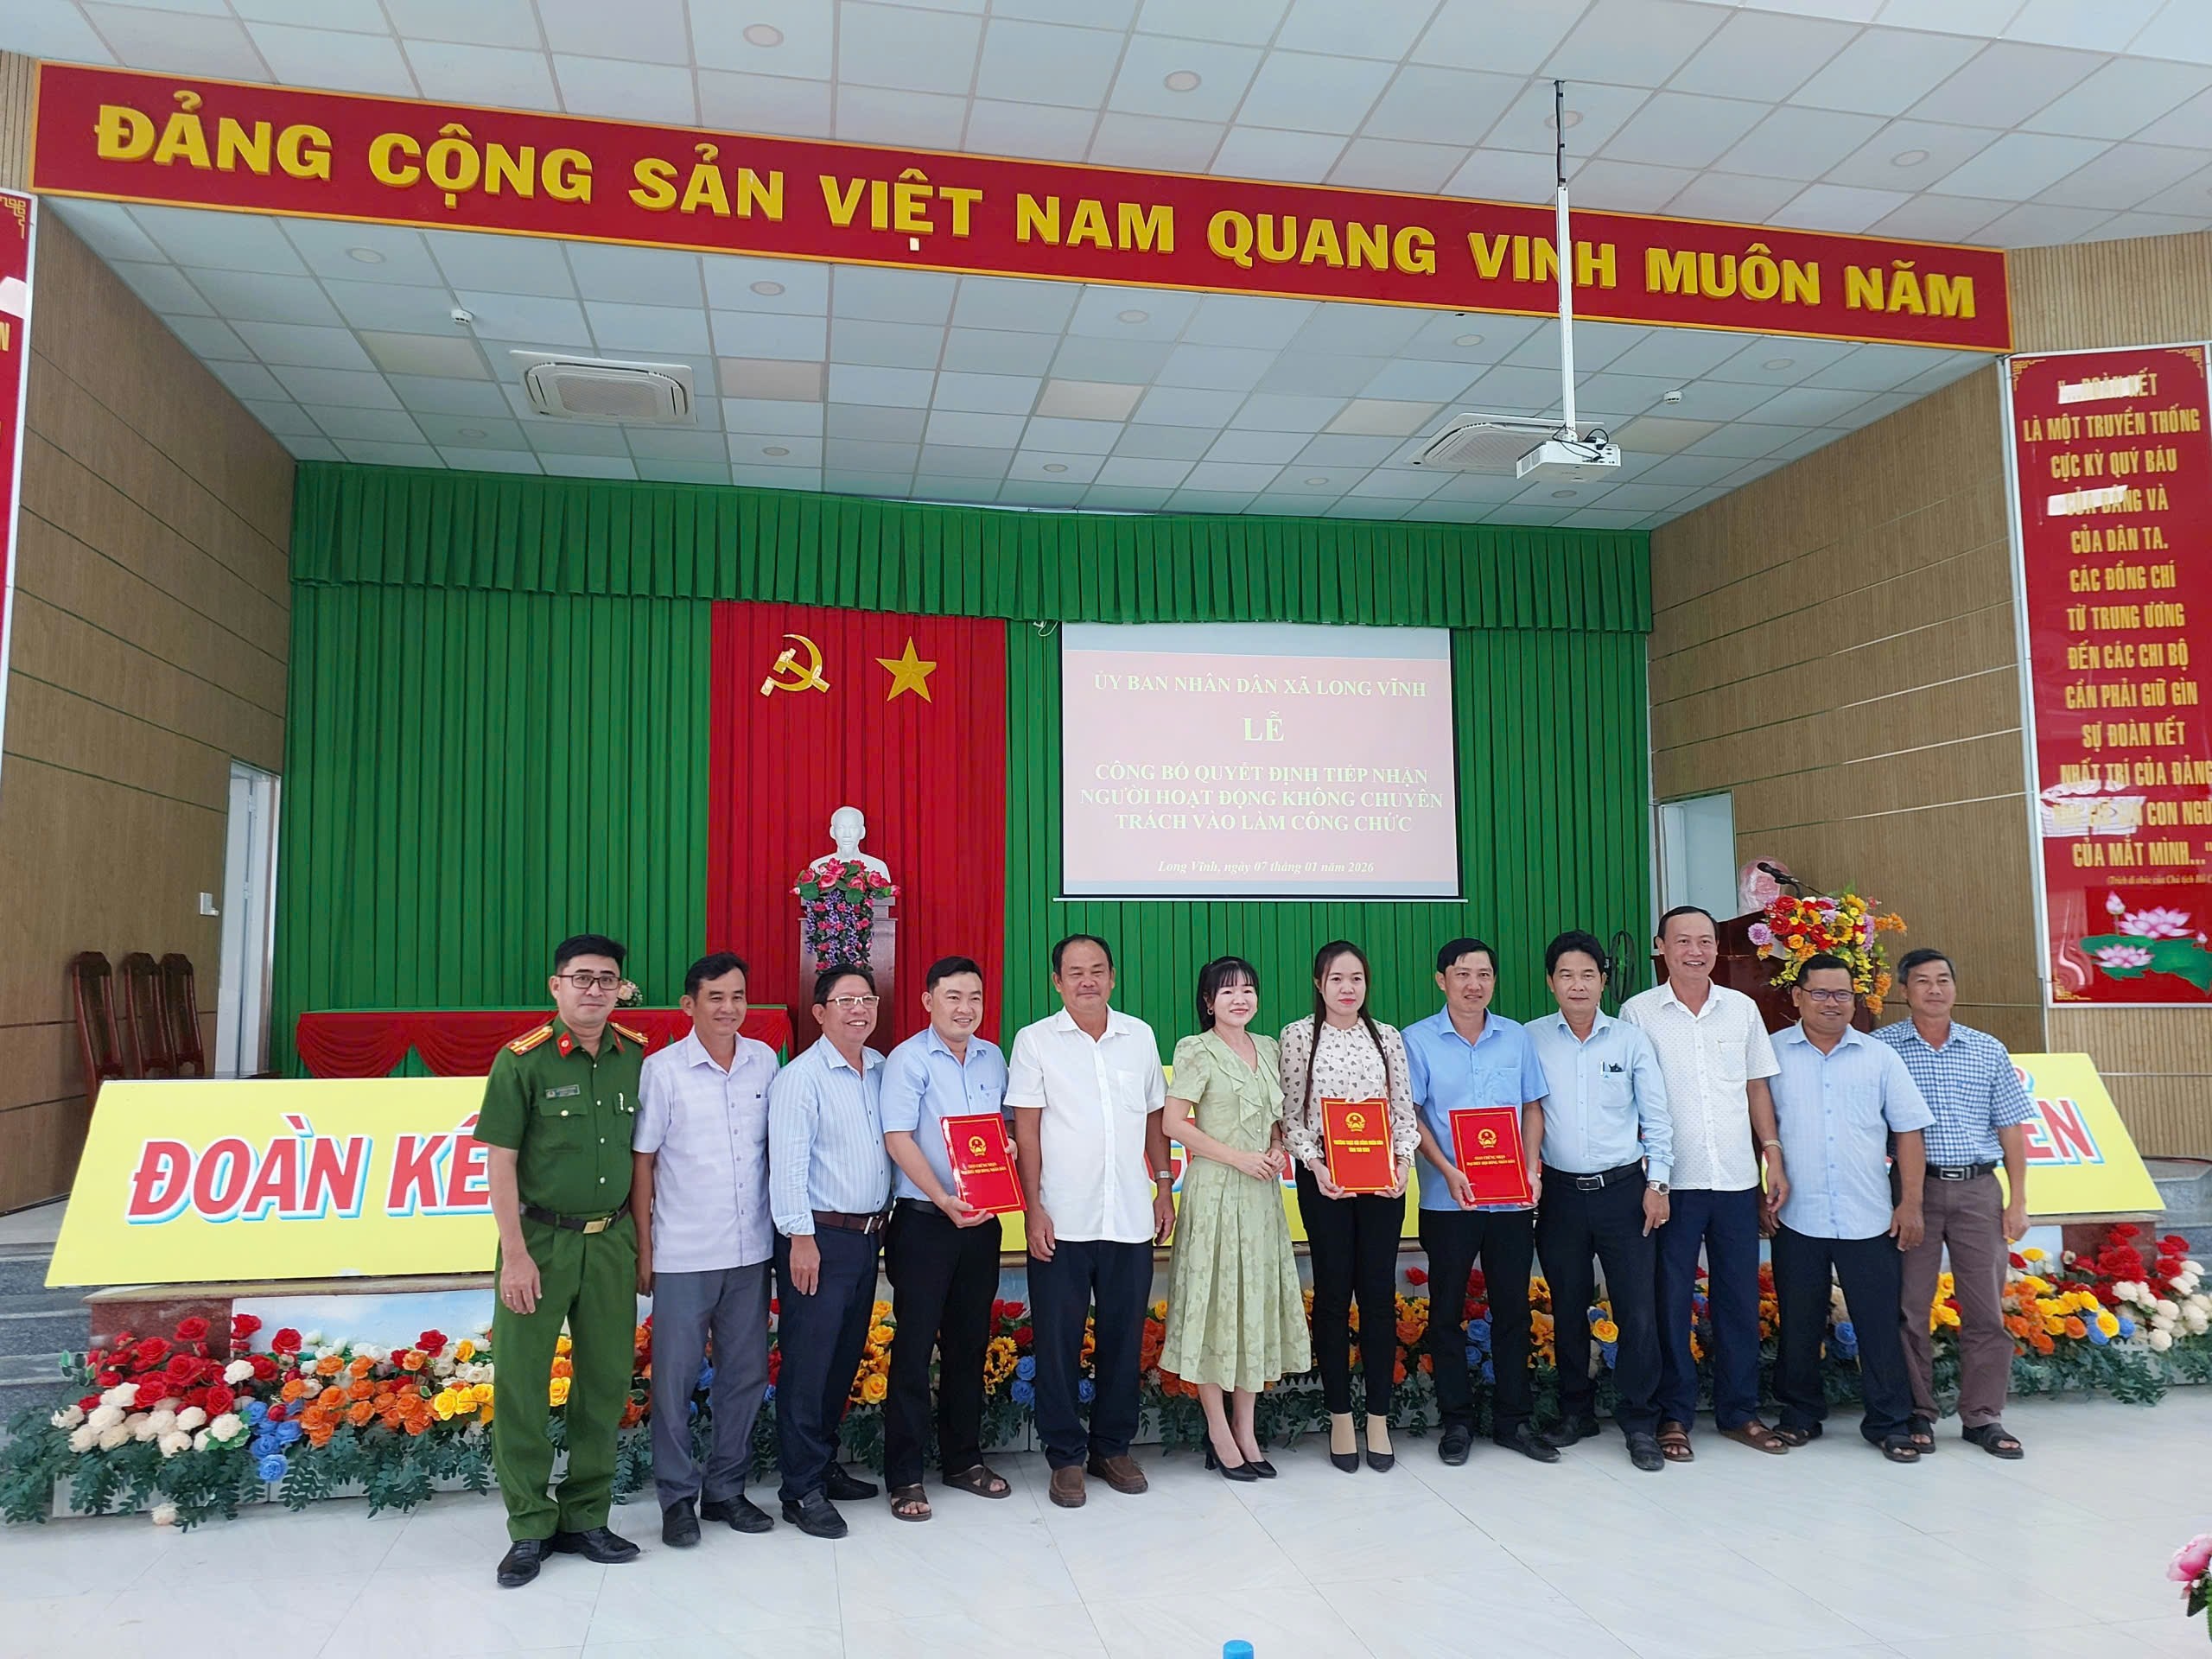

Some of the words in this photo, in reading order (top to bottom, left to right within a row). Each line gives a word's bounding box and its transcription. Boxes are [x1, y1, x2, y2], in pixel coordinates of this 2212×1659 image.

[93, 89, 332, 181] ĐẢNG
[368, 123, 594, 210] CỘNG
[628, 142, 784, 222] SẢN
[818, 168, 983, 252] VIỆT
[1015, 193, 1175, 254] NAM
[1207, 210, 1437, 276] QUANG
[1467, 232, 1617, 289] VINH
[1644, 243, 1821, 306] MUÔN
[1845, 261, 1977, 320] NĂM
[2023, 415, 2043, 442] LÀ
[2046, 413, 2080, 445] MỘT
[2085, 406, 2146, 439] TRUYỀN
[2150, 403, 2201, 434] THỐNG
[2050, 452, 2081, 482] CỰC
[2084, 449, 2104, 476] KỲ
[2109, 447, 2139, 478] QUÝ
[2145, 445, 2177, 473] BÁU
[2146, 483, 2170, 512] VÀ
[2070, 524, 2103, 554] CỦA
[2106, 524, 2139, 552] DÂN
[2142, 526, 2169, 550] TA.
[2069, 564, 2101, 593] CÁC
[2104, 560, 2147, 591] ĐỒNG
[2150, 559, 2176, 589] CHÍ
[2066, 603, 2087, 631] TỪ
[2091, 605, 2140, 630] TRUNG
[2144, 601, 2185, 628] ƯƠNG
[2067, 639, 2101, 671] ĐẾN
[2103, 640, 2135, 669] CÁC
[2139, 643, 2164, 668] CHI
[2167, 638, 2190, 671] BỘ
[1127, 675, 1169, 691] BAN
[1174, 672, 1230, 692] NHÂN
[1236, 673, 1277, 693] DÂN
[1284, 676, 1311, 694] XÃ
[1316, 679, 1372, 696] LONG
[1377, 678, 1427, 697] VĨNH
[2065, 678, 2098, 709] CẦN
[2101, 677, 2138, 708] PHẢI
[2141, 677, 2166, 707] GIỮ
[2171, 677, 2198, 706] GÌN
[1244, 710, 1285, 741] LỄ
[2082, 721, 2103, 753] SỰ
[2107, 719, 2152, 747] ĐOÀN
[2154, 715, 2185, 746] KẾT
[1095, 760, 1155, 780] CÔNG
[1161, 760, 1190, 780] BỐ
[1195, 762, 1263, 783] QUYẾT
[1268, 766, 1318, 785] ĐỊNH
[1324, 762, 1368, 782] TIẾP
[1372, 766, 1427, 787] NHẬN
[2060, 756, 2101, 785] NHẤT
[2105, 757, 2130, 786] TRÍ
[2134, 755, 2167, 786] CỦA
[1080, 785, 1150, 805] NGƯỜI
[1155, 788, 1213, 808] HOẠT
[1218, 787, 1276, 809] ĐỘNG
[1282, 787, 1356, 807] KHÔNG
[1360, 788, 1443, 808] CHUYÊN
[1115, 810, 1187, 830] TRÁCH
[1192, 810, 1236, 830] VÀO
[1242, 810, 1286, 830] LÀM
[1291, 810, 1348, 830] CÔNG
[1354, 811, 1412, 832] CHỨC
[2146, 801, 2178, 826] CON
[1158, 861, 1187, 873] Long
[1191, 861, 1221, 873] Vĩnh,
[1224, 861, 1250, 874] ngày
[1254, 861, 1268, 872] 07
[1270, 861, 1300, 874] tháng
[1305, 861, 1317, 873] 01
[1320, 862, 1345, 873] năm
[1348, 862, 1374, 873] 2026
[2072, 836, 2106, 868] CỦA
[126, 1113, 372, 1223] ĐOÀN
